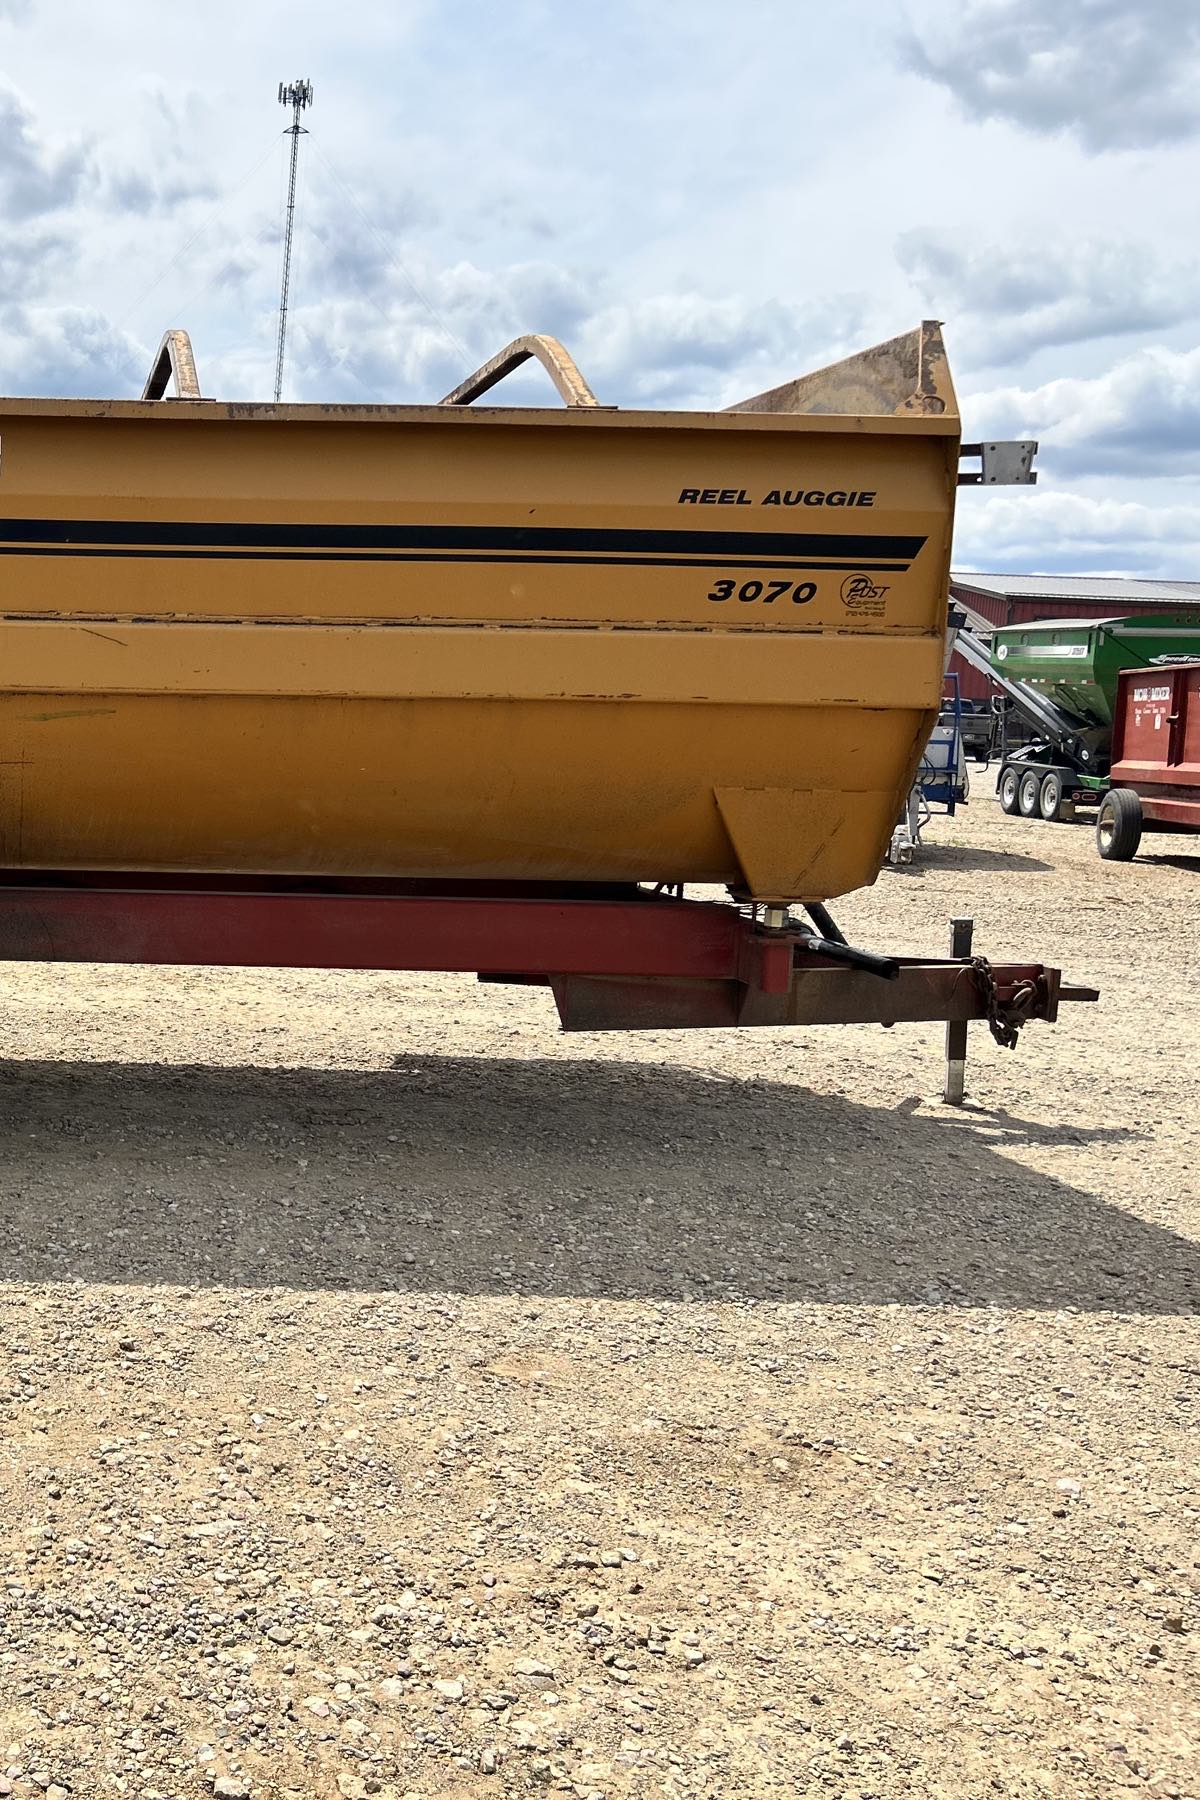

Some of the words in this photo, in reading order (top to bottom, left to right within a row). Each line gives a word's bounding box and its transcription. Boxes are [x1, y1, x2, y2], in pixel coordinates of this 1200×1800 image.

[678, 488, 752, 505] REEL
[760, 490, 877, 507] AUGGIE
[707, 579, 818, 604] 3070
